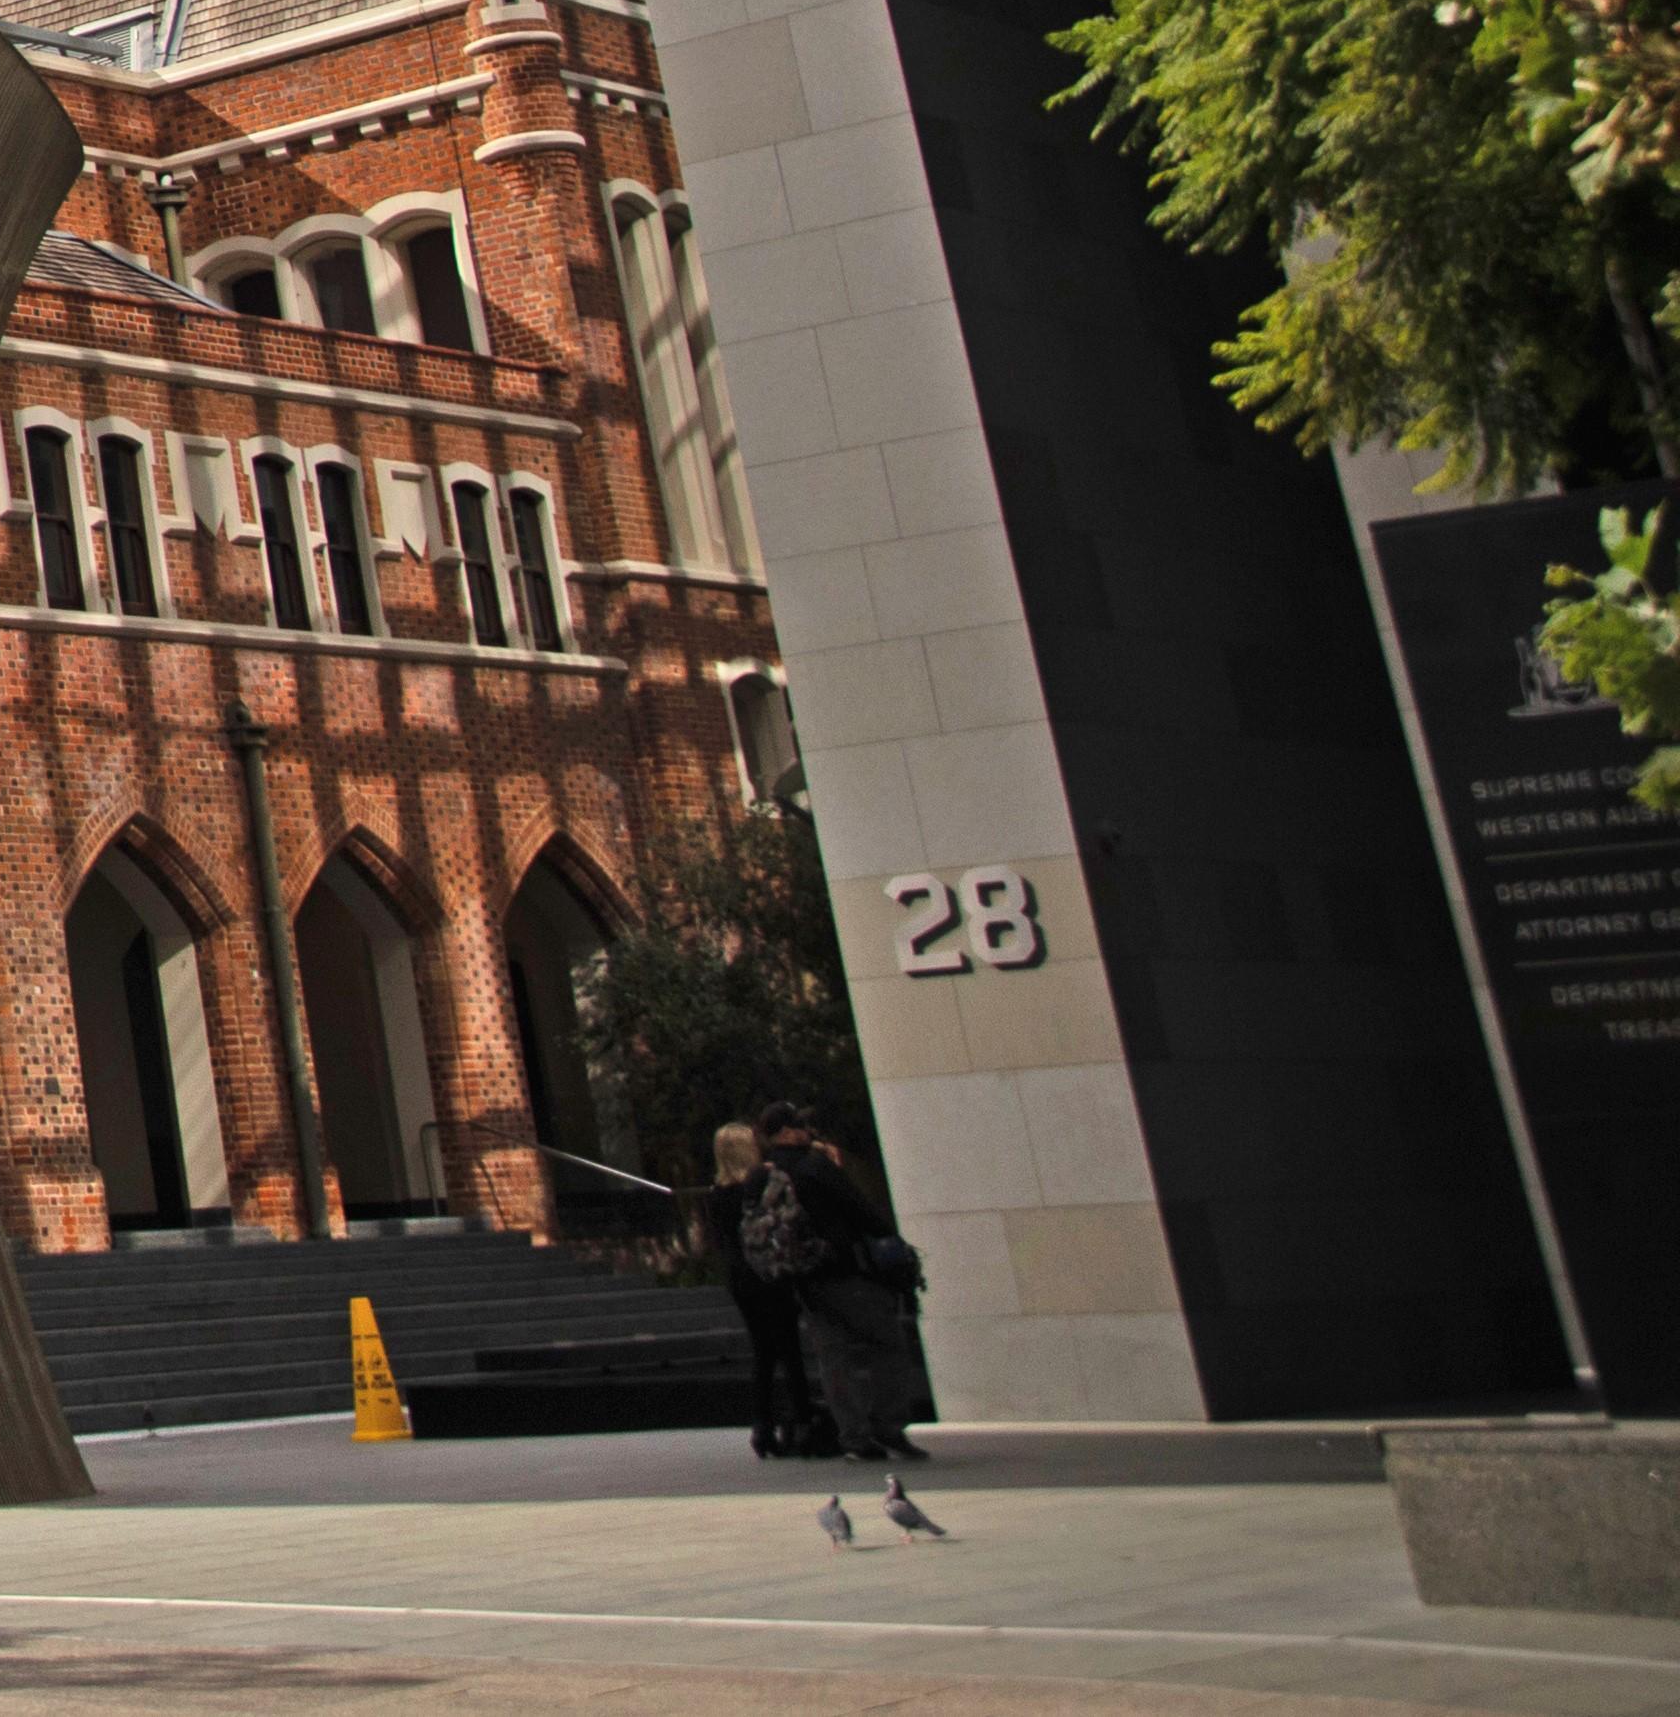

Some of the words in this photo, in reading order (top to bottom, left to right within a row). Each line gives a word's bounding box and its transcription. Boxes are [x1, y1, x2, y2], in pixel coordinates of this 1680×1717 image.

[1470, 768, 1594, 800] SUPREME
[1475, 809, 1598, 838] WESTERN
[1494, 869, 1663, 903] DEPARTMENT
[884, 863, 1044, 976] 28
[1514, 912, 1643, 941] ATTORNEY
